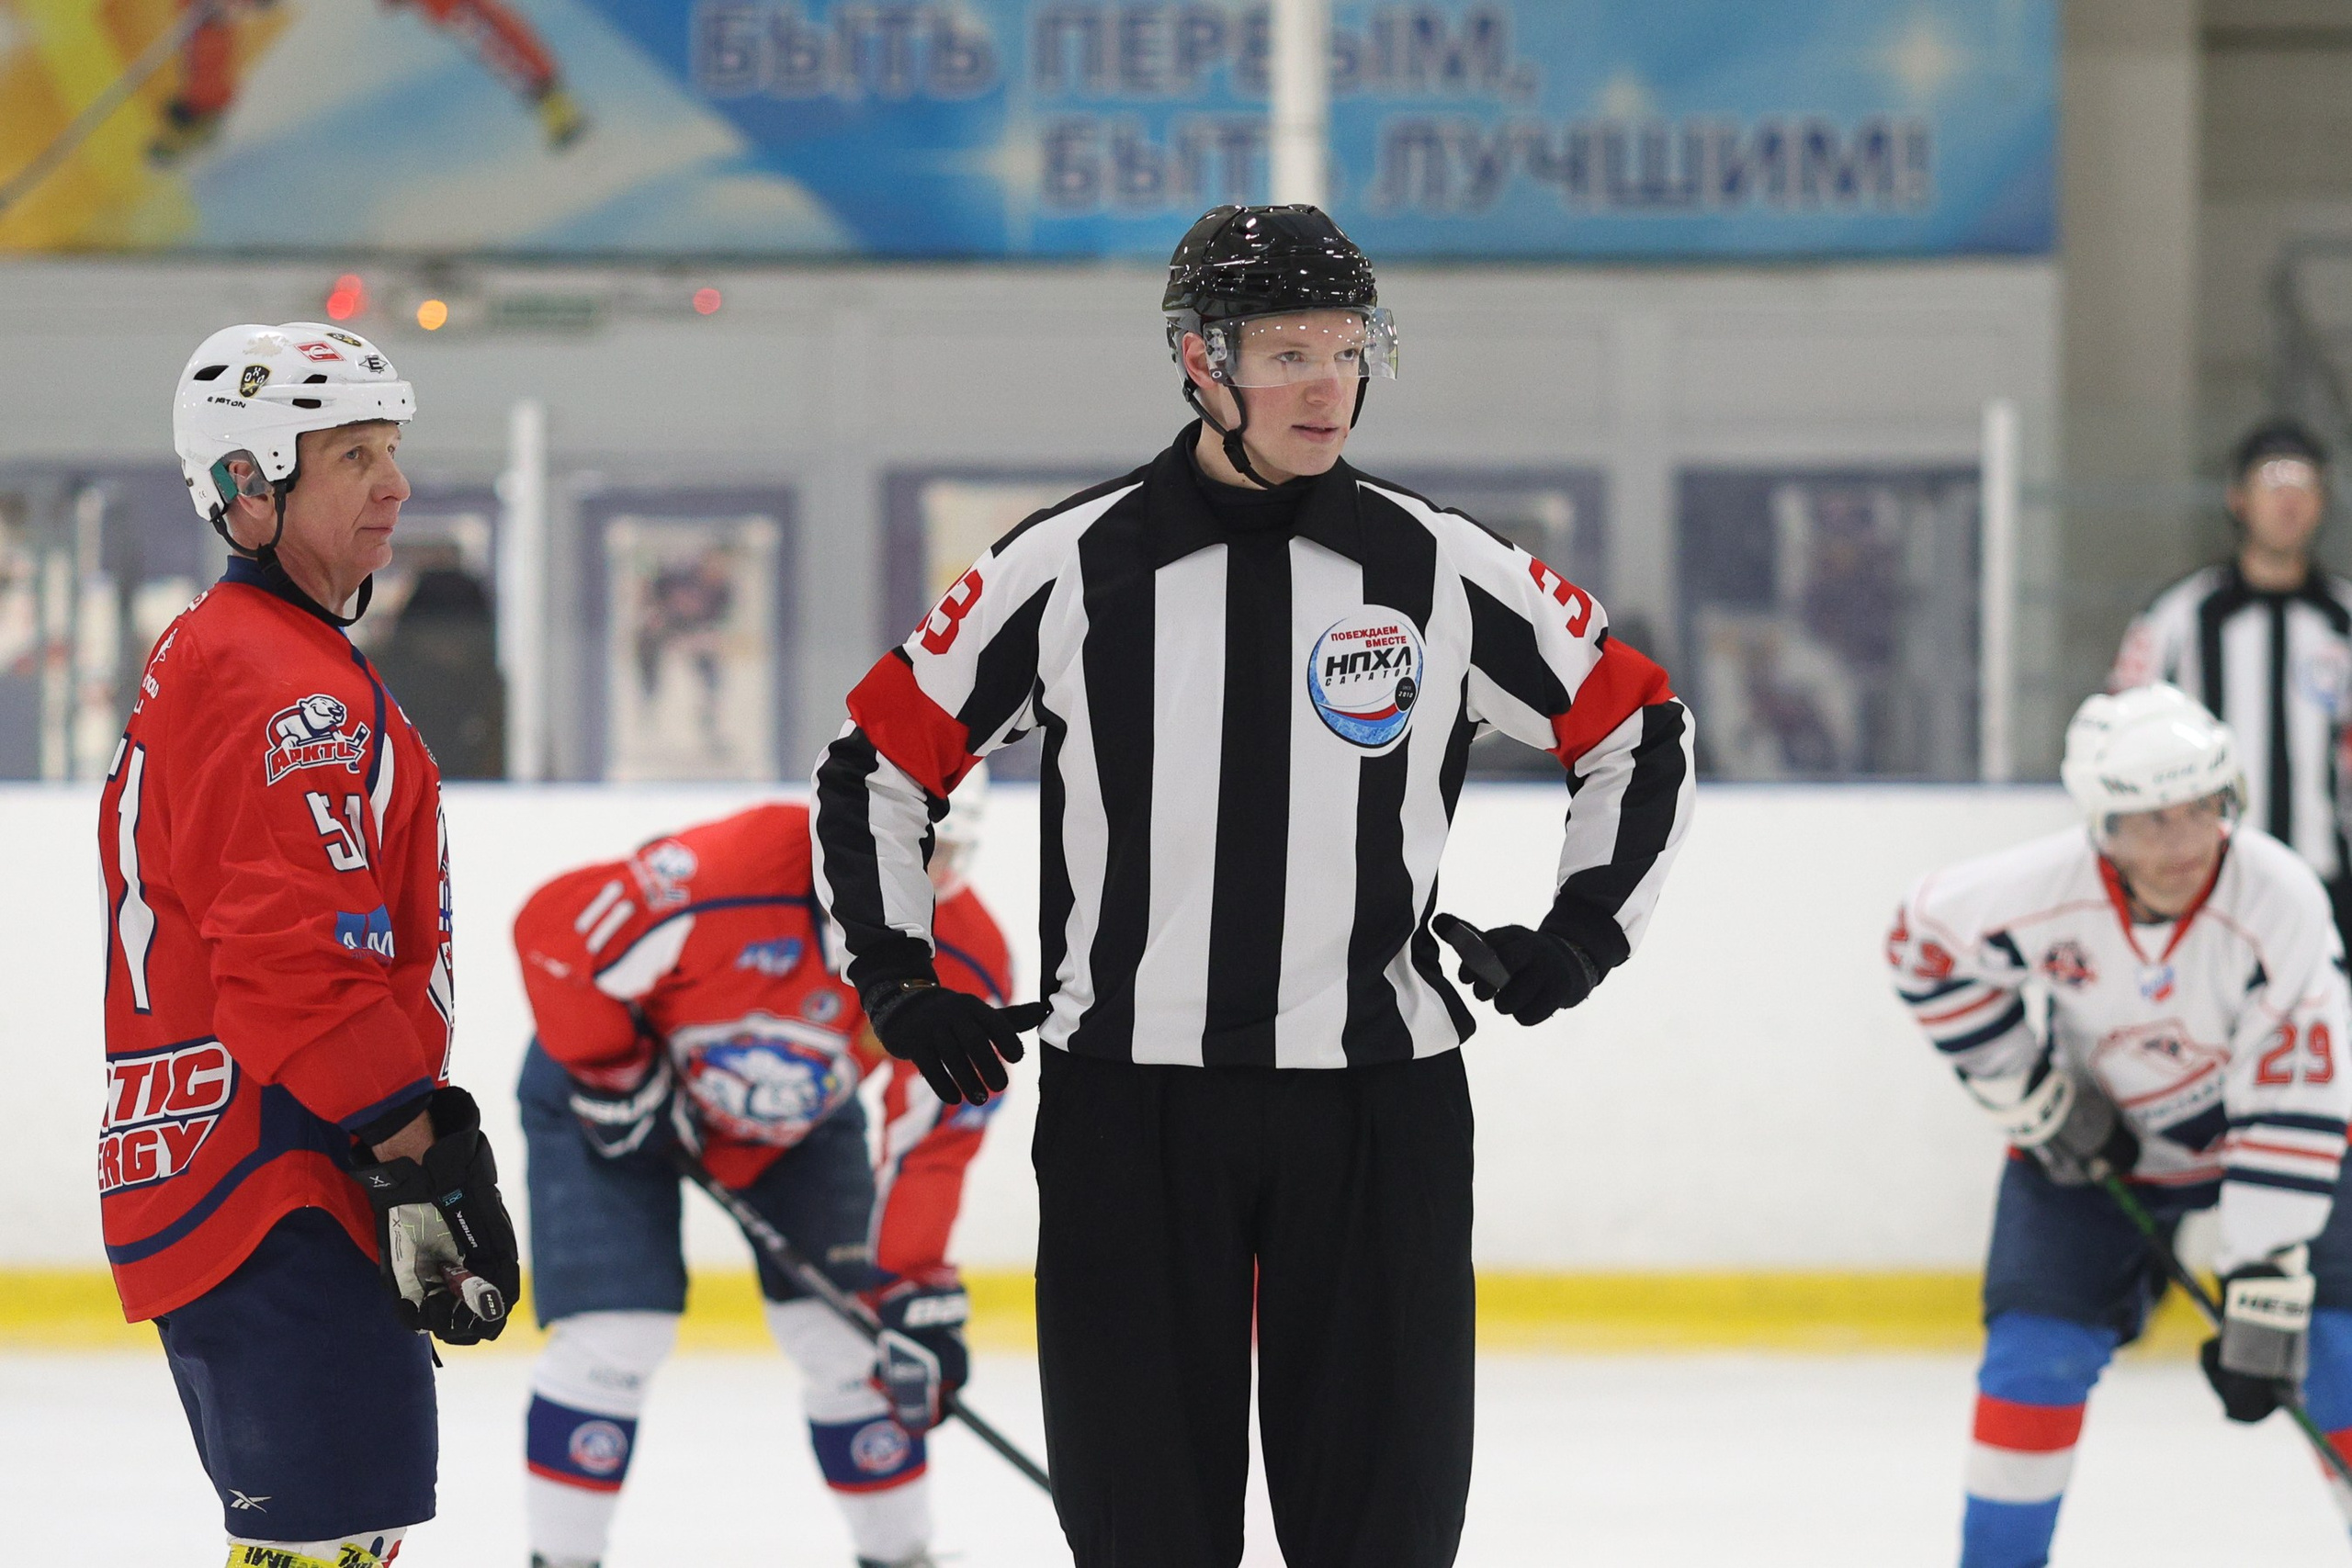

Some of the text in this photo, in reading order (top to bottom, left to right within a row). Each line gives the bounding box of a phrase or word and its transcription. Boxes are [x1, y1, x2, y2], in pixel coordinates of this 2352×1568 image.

[694, 2, 1000, 96] БЫТЬ
[1038, 114, 1931, 215] БЫТ ЛУЧШИМ!
[1325, 646, 1412, 678] НПХЛ
[1330, 625, 1399, 642] ПОБЕЖДАЕМ
[1365, 636, 1408, 649] ВМЕСТЕ
[1325, 667, 1412, 687] САРАТОВ
[304, 790, 371, 873] 51
[2254, 1021, 2335, 1086] 29
[103, 1043, 230, 1131] TIC
